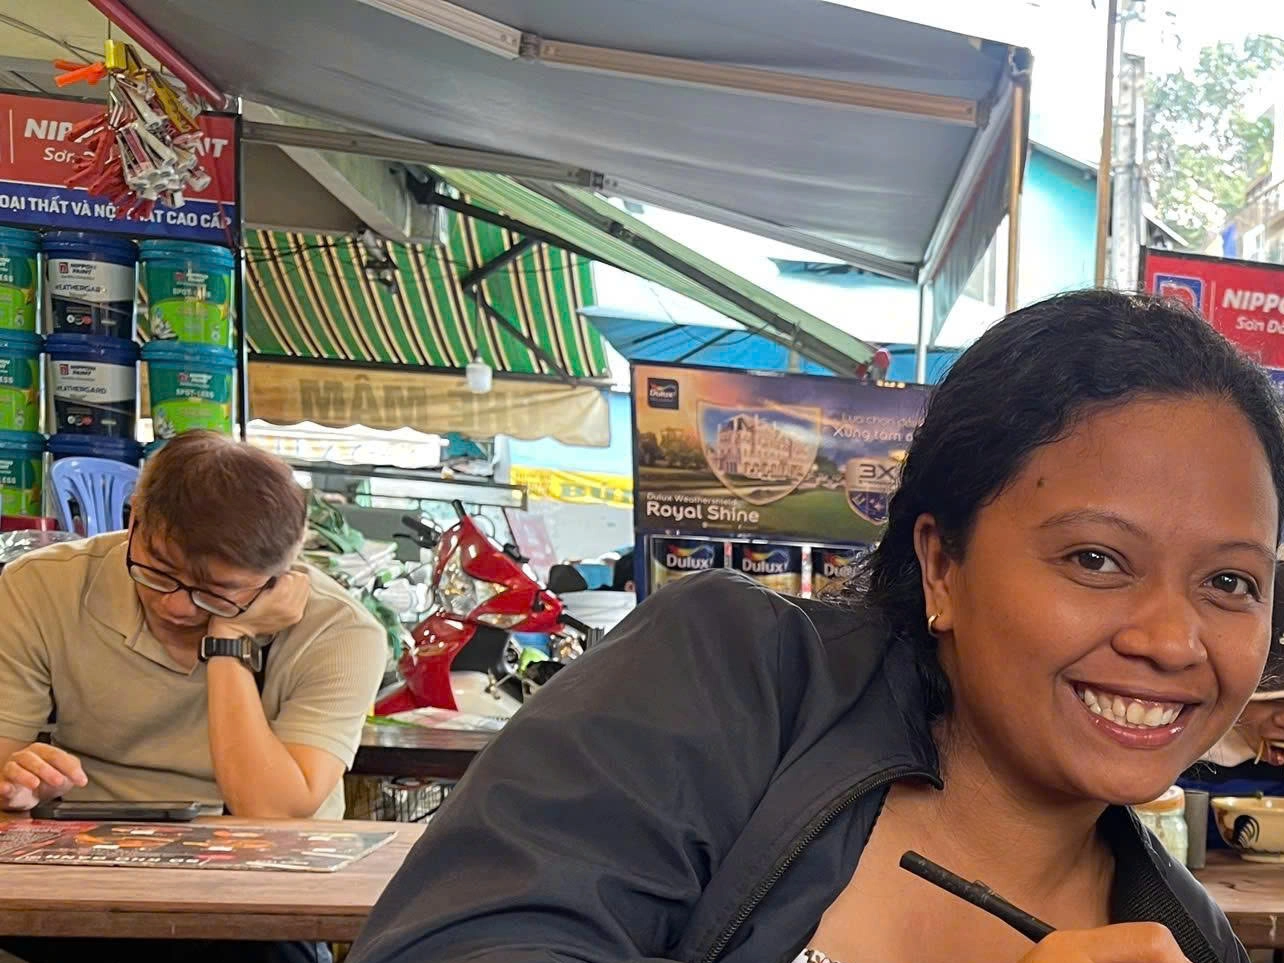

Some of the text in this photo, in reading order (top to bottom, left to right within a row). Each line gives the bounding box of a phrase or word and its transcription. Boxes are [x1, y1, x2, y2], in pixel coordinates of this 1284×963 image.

[28, 195, 69, 214] THẤT
[71, 200, 92, 217] VÀ
[94, 202, 119, 221] NỘ
[166, 211, 198, 226] CAO
[859, 464, 896, 480] 3X
[646, 491, 672, 502] Dulux
[646, 501, 760, 523] Royal Shine
[666, 554, 710, 570] Dulux
[742, 558, 785, 574] Dulux
